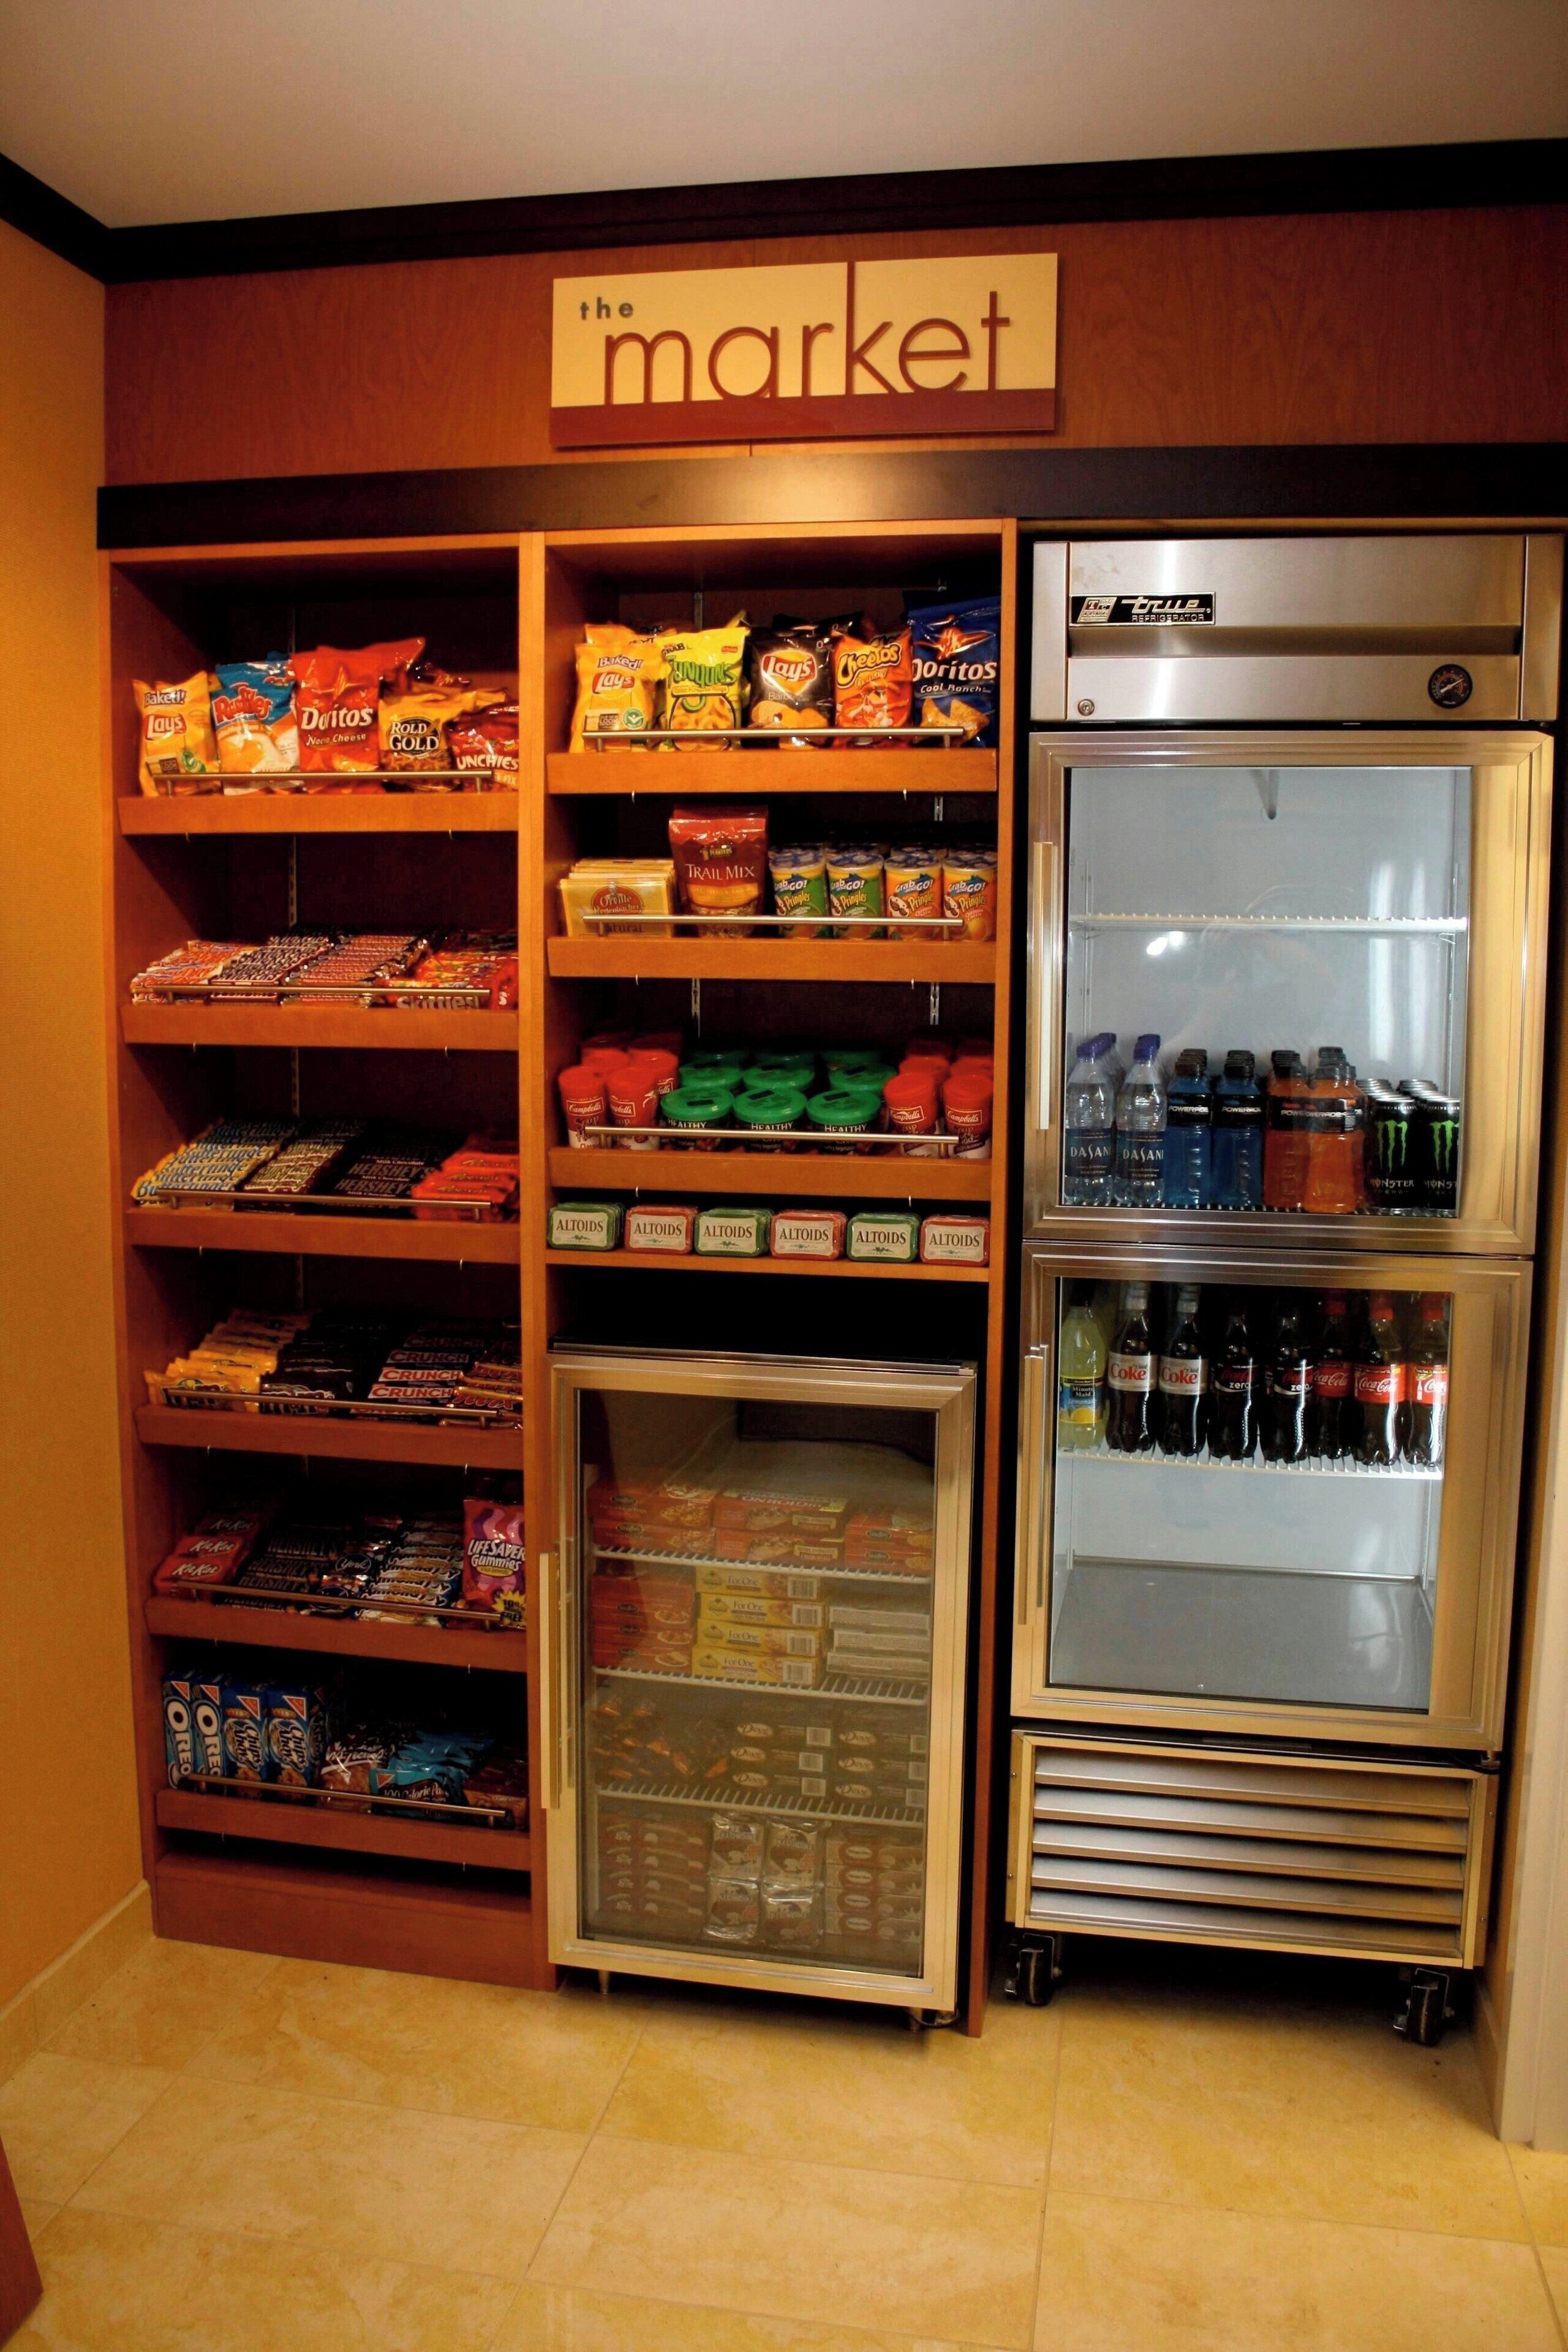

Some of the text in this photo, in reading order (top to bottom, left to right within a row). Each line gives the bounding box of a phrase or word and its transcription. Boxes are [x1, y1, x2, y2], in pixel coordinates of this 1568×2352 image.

[579, 297, 634, 320] the
[605, 262, 1011, 405] market
[1121, 597, 1205, 613] true
[1132, 614, 1204, 622] REFRIGERATOR
[598, 654, 644, 671] Baked!
[837, 643, 900, 688] Cheetos
[920, 684, 981, 693] Cool Ranch
[145, 688, 187, 708] Baked!
[301, 704, 374, 730] Doritos
[390, 721, 428, 734] ROLD
[333, 733, 366, 743] Cheese
[389, 735, 440, 751] GOLD
[456, 754, 519, 771] UNCHIES
[685, 864, 755, 880] TRAIL MIX
[789, 880, 808, 891] GO!
[846, 880, 865, 891] GO!
[916, 879, 933, 891] GO!
[967, 881, 986, 892] GO!
[600, 893, 632, 907] Orville
[783, 890, 811, 910] Pringles
[840, 890, 867, 910] Pringles
[907, 892, 934, 912] Pringles
[958, 894, 987, 913] Pringles
[1123, 1147, 1164, 1162] DASANI
[1424, 1178, 1457, 1189] MONST
[556, 1219, 604, 1232] ALTOIDS
[633, 1222, 682, 1236] ALTOIDS
[704, 1225, 753, 1238] ALTOIDS
[779, 1227, 830, 1242] ALTOIDS
[856, 1231, 907, 1245] ALTOIDS
[929, 1233, 980, 1247] ALTOIDS
[390, 1351, 468, 1362] CRUNCH
[382, 1370, 460, 1380] CRUNCH
[1110, 1363, 1147, 1380] Coke
[1161, 1366, 1197, 1384] Coke
[372, 1387, 452, 1397] CRUNCH
[1291, 1382, 1310, 1392] zeo
[468, 1539, 526, 1561] LIFESAVER
[471, 1554, 523, 1572] Gummies
[742, 1577, 759, 1585] One
[733, 1600, 764, 1610] For One
[742, 1631, 758, 1640] One
[724, 1656, 755, 1667] For One
[166, 1699, 194, 1775] OREO
[195, 1701, 221, 1776] OREO
